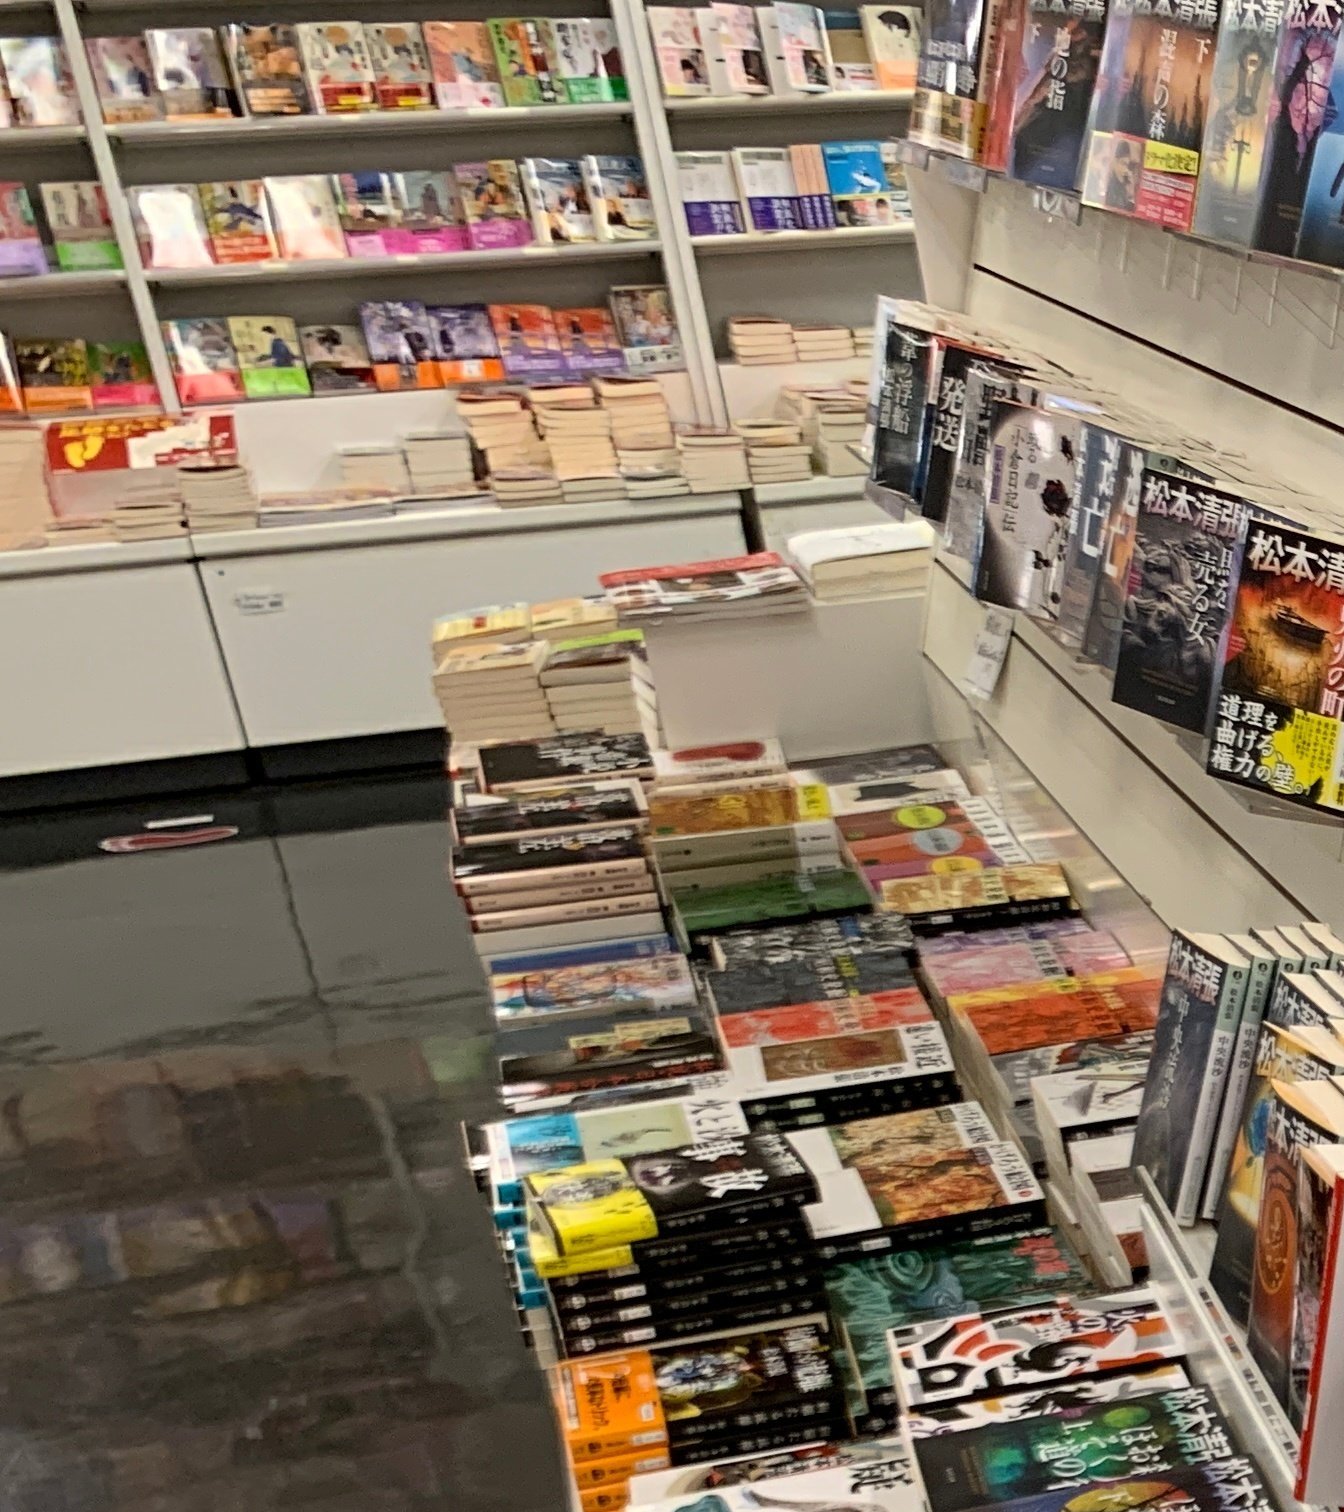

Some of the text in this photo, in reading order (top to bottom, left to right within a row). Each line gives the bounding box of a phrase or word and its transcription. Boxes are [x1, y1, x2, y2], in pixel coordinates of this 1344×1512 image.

[1220, 693, 1279, 732] 道理を
[1210, 747, 1305, 794] 権力の壁。
